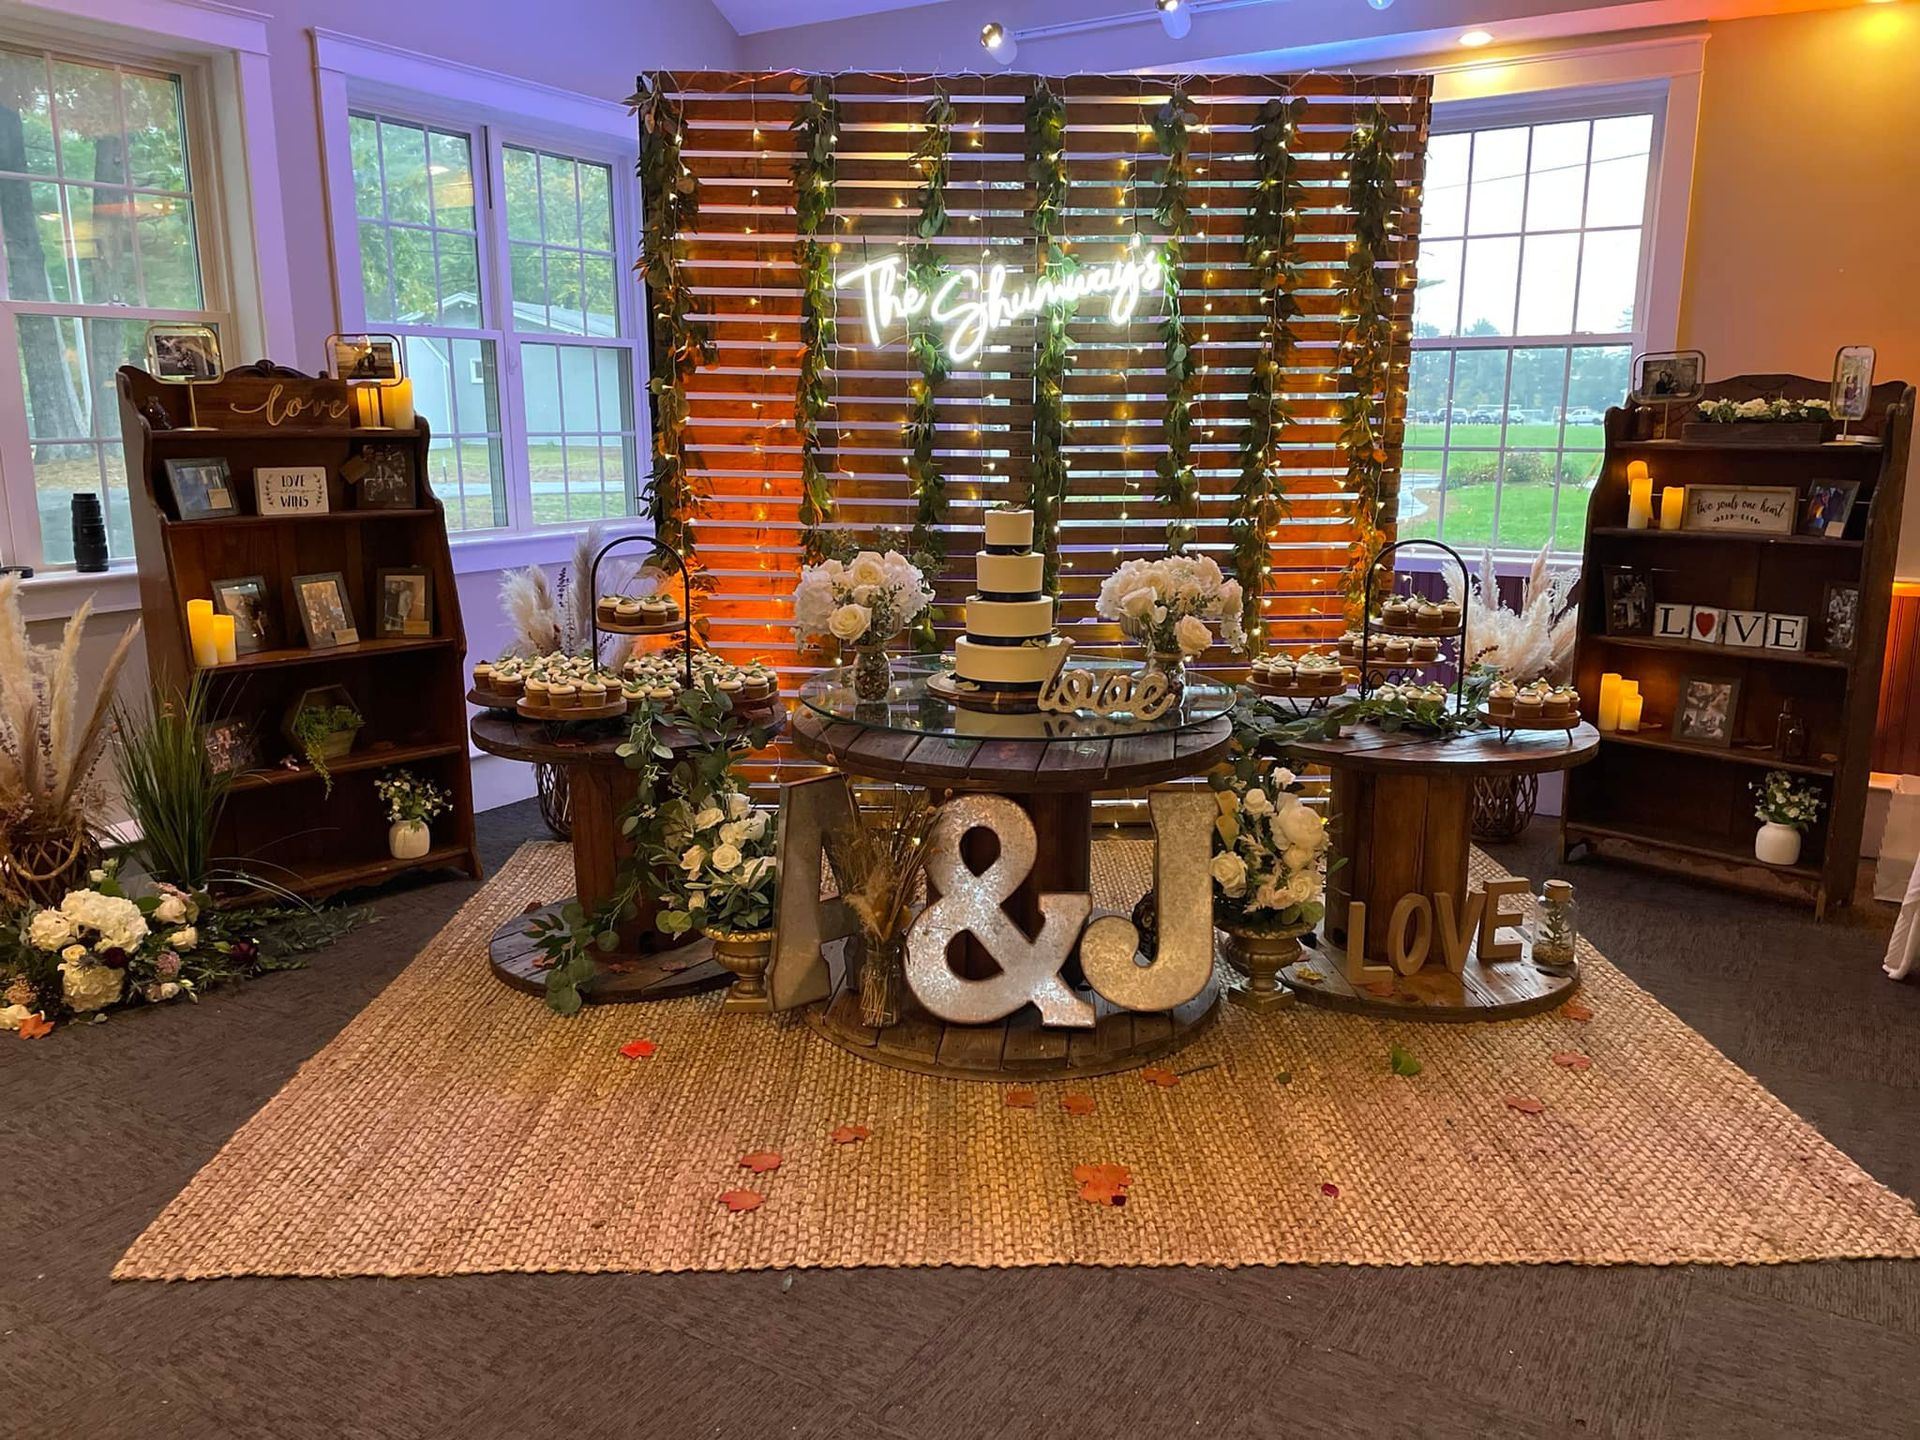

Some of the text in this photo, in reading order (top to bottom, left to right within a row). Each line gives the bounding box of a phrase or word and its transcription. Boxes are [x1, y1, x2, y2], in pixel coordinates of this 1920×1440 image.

[836, 256, 927, 347] The
[230, 384, 350, 426] love
[280, 494, 309, 508] WINS
[281, 474, 305, 488] LOVE
[1695, 494, 1786, 518] two souls one heart
[1037, 636, 1176, 721] love
[905, 793, 1096, 1028] &
[1079, 790, 1222, 1012] J
[1347, 877, 1531, 985] LOVE
